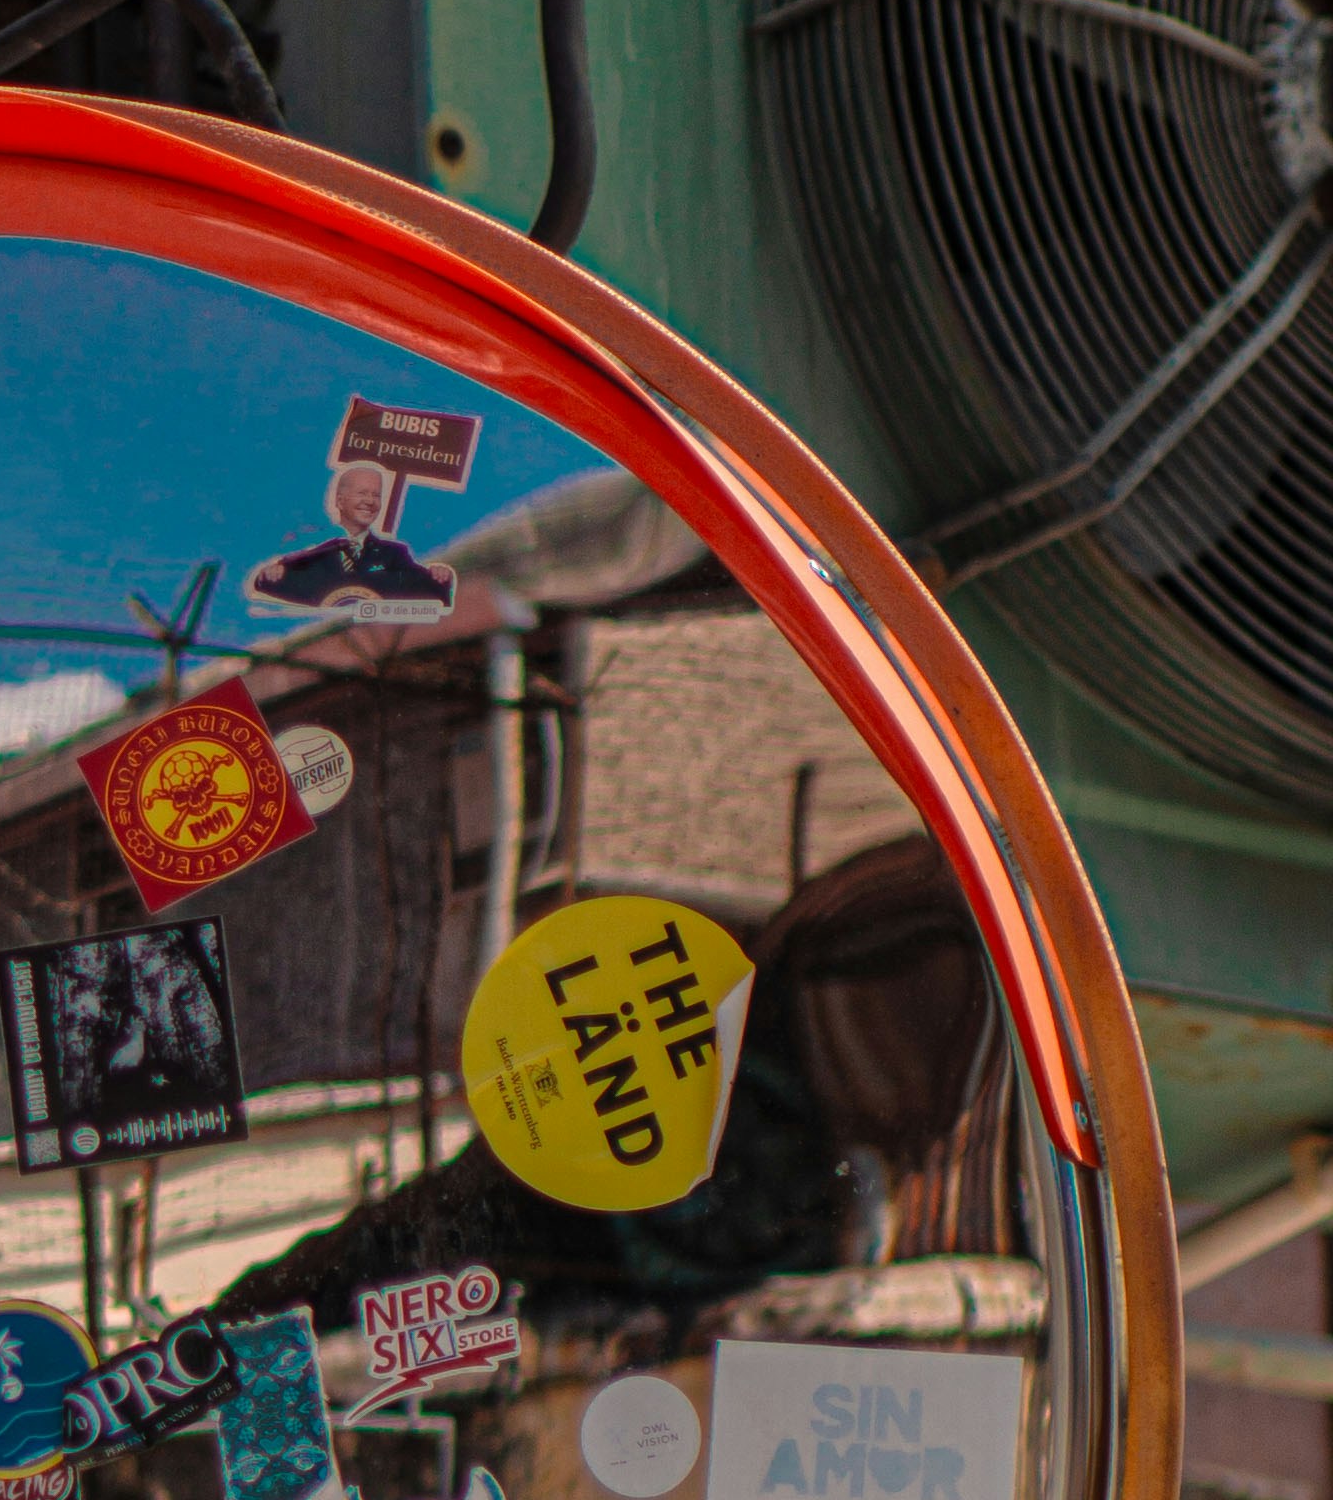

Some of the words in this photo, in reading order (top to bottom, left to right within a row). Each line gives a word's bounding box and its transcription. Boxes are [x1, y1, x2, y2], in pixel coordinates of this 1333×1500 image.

[346, 431, 374, 451] for
[376, 440, 462, 467] president
[379, 411, 441, 437] BUBIS
[177, 713, 265, 761] BULOH
[288, 755, 347, 793] OFSCHIP
[158, 800, 280, 876] VANDALS
[629, 920, 717, 1081] THE
[544, 954, 664, 1167] LÄND
[363, 1267, 500, 1336] NERO
[372, 1319, 458, 1374] SIX
[457, 1323, 515, 1350] STORE
[641, 1422, 671, 1437] OWL
[809, 1382, 924, 1443] SIN
[636, 1432, 680, 1450] VISION
